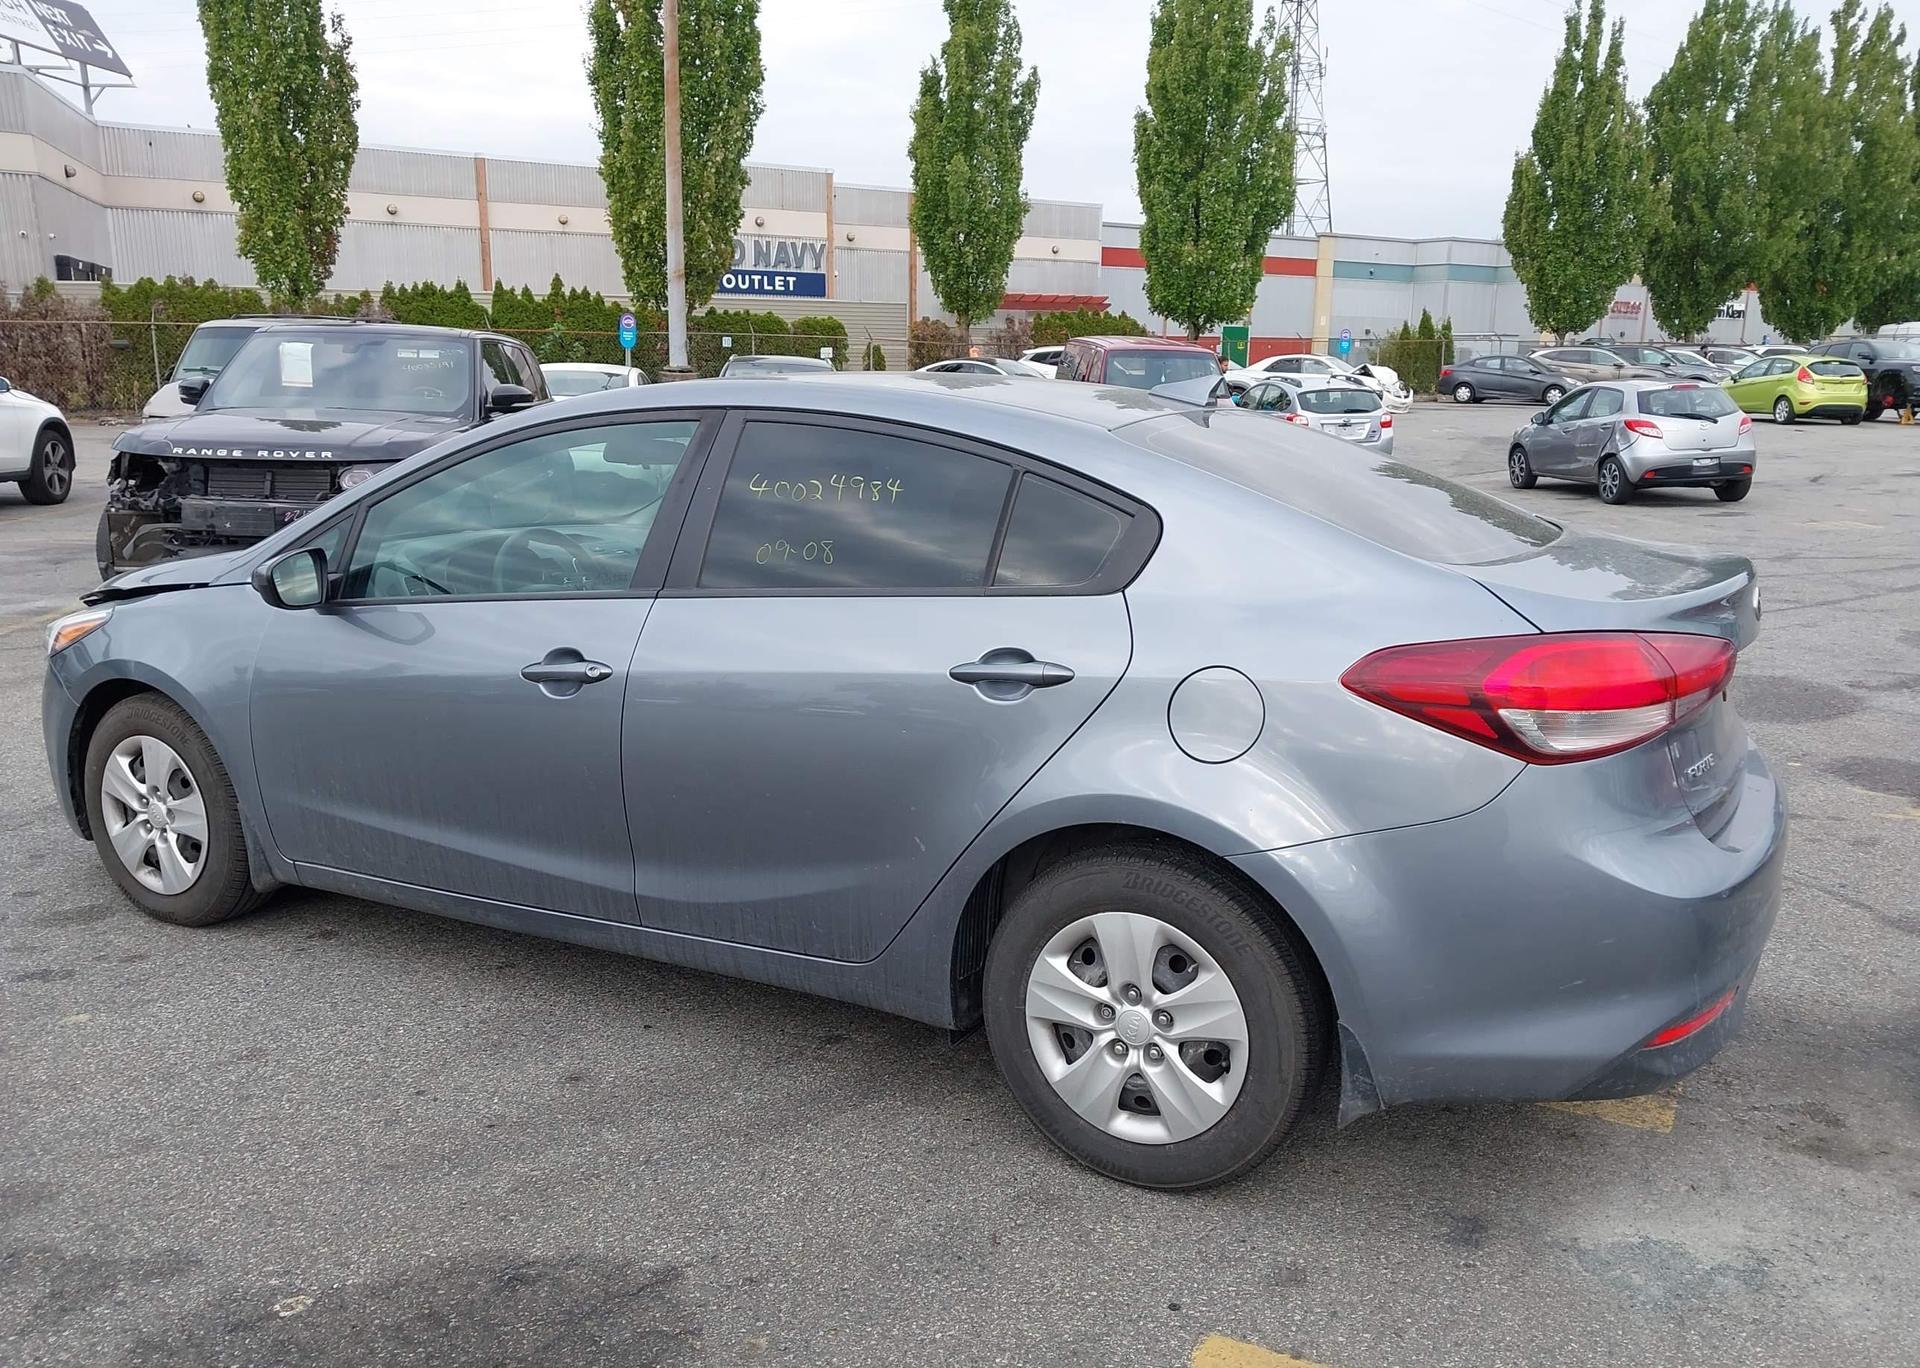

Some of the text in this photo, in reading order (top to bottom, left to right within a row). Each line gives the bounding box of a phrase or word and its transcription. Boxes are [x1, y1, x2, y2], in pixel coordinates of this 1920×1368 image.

[30, 0, 72, 27] NEXT
[46, 24, 91, 52] EXIT
[753, 240, 826, 270] NAVY
[722, 273, 797, 291] OUTLET
[172, 447, 333, 459] RANGE ROVER
[750, 473, 904, 504] 40024984
[756, 540, 833, 565] 09-08
[1122, 871, 1252, 957] BRIDGESTONE
